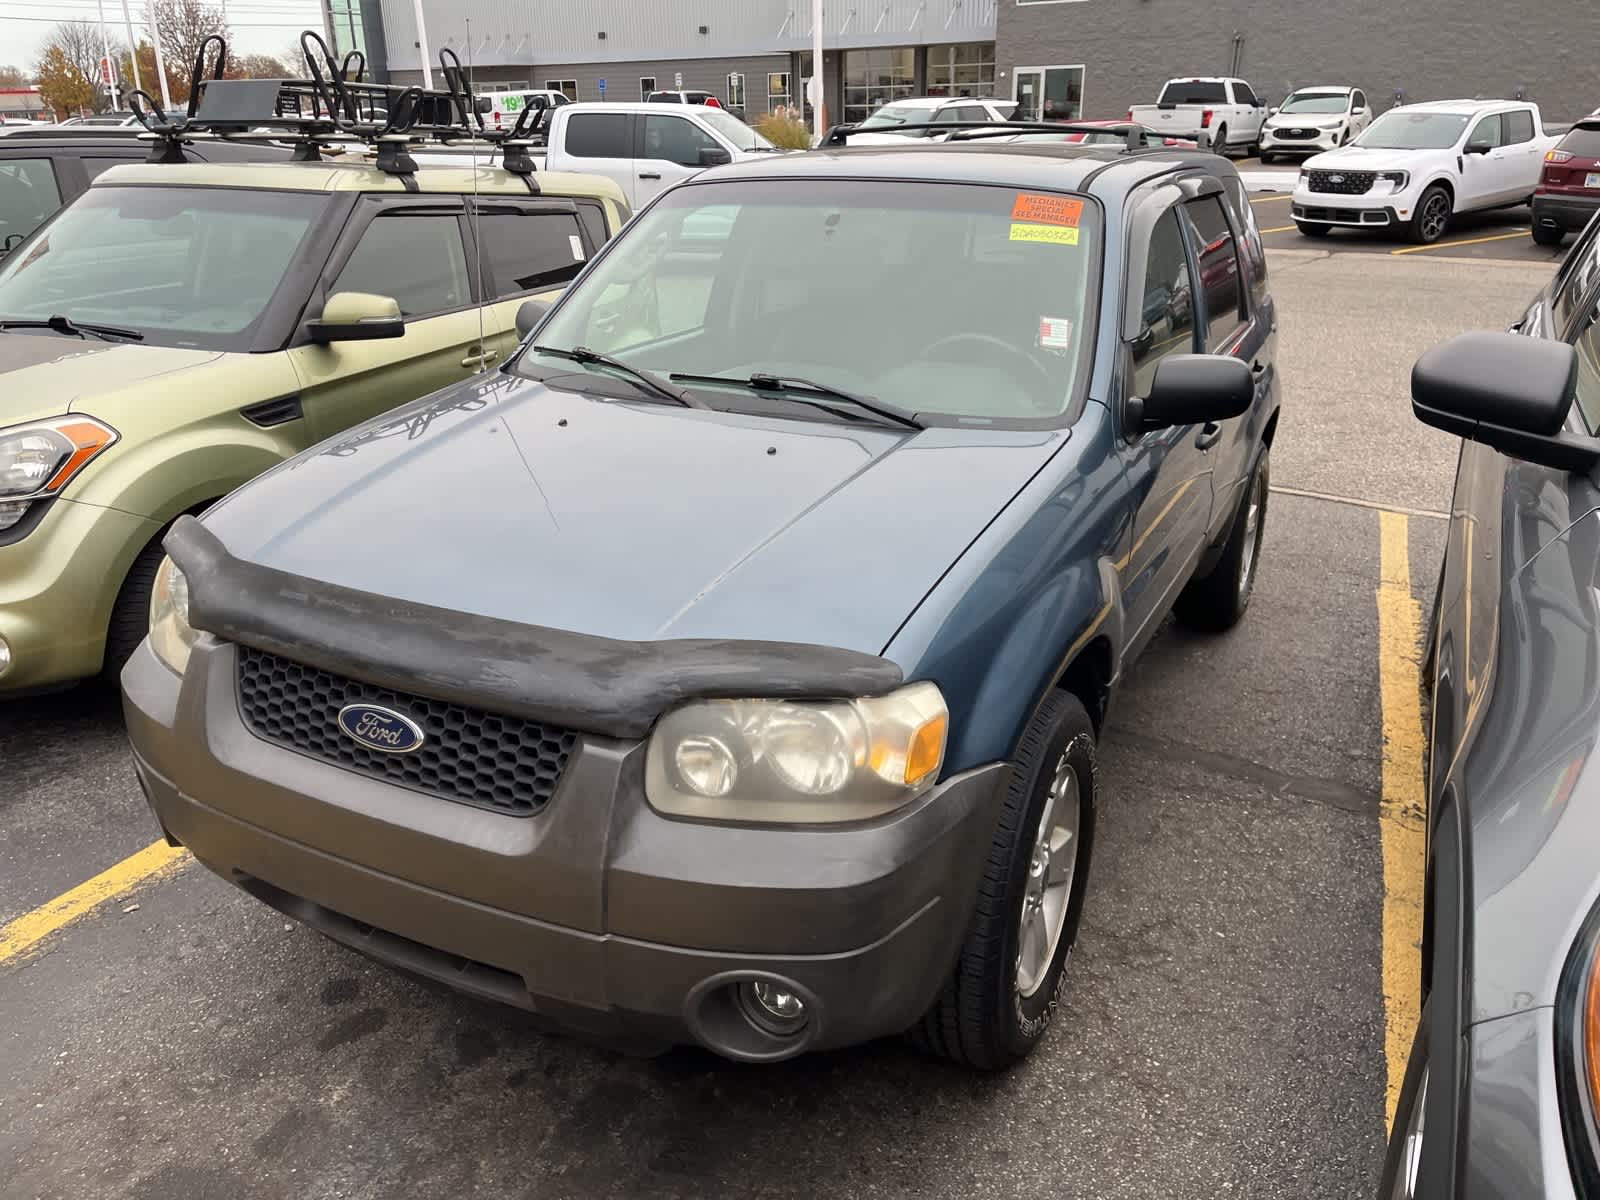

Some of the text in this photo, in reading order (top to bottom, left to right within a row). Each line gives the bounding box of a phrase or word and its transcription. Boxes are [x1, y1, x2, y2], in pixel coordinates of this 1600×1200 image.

[1025, 197, 1075, 209] MECHANICS
[1031, 205, 1065, 215] SPECIAL
[1015, 210, 1078, 225] SEE MANAGER
[356, 711, 403, 744] Ford
